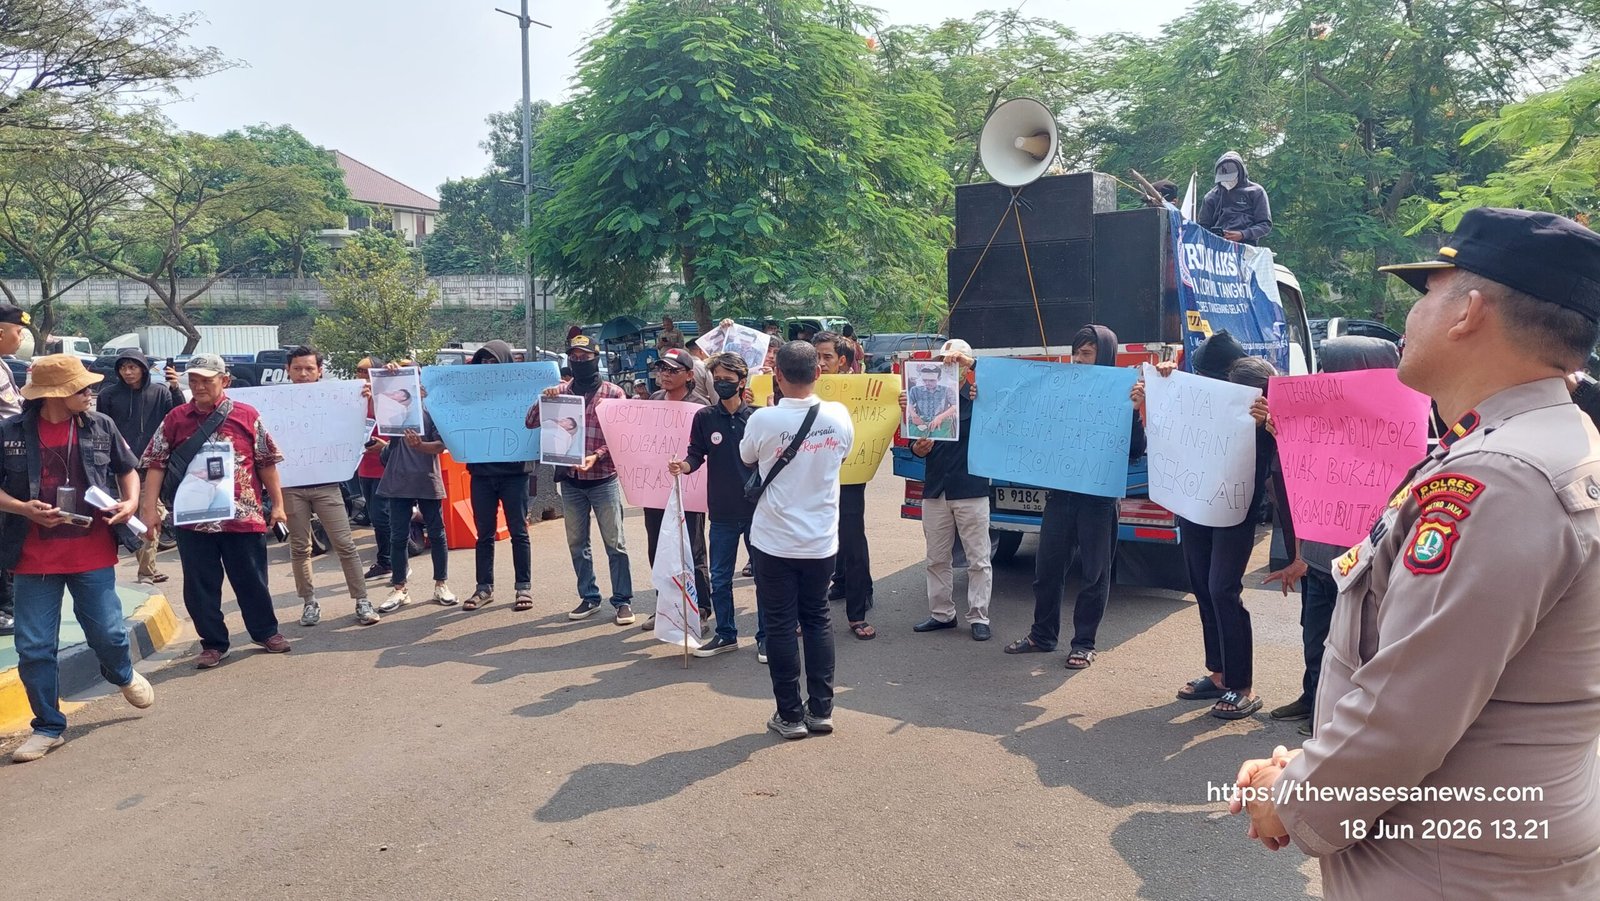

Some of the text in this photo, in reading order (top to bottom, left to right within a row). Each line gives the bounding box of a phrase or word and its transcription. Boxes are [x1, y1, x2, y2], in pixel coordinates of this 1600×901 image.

[261, 368, 292, 384] POL
[1160, 380, 1214, 419] SAYA
[1278, 378, 1345, 405] TEGAKKAN
[604, 404, 694, 428] USUT TUN
[851, 405, 887, 423] ANAK
[620, 434, 680, 454] DUGAAN
[979, 415, 1129, 456] KARENA FAKTOR
[1005, 444, 1115, 485] EKONOMI
[1284, 453, 1394, 491] ANAK BUKAN
[1151, 452, 1248, 510] SEKOLAH
[1420, 478, 1475, 495] POLRES
[997, 489, 1005, 501] B
[1445, 503, 1463, 516] JAYA
